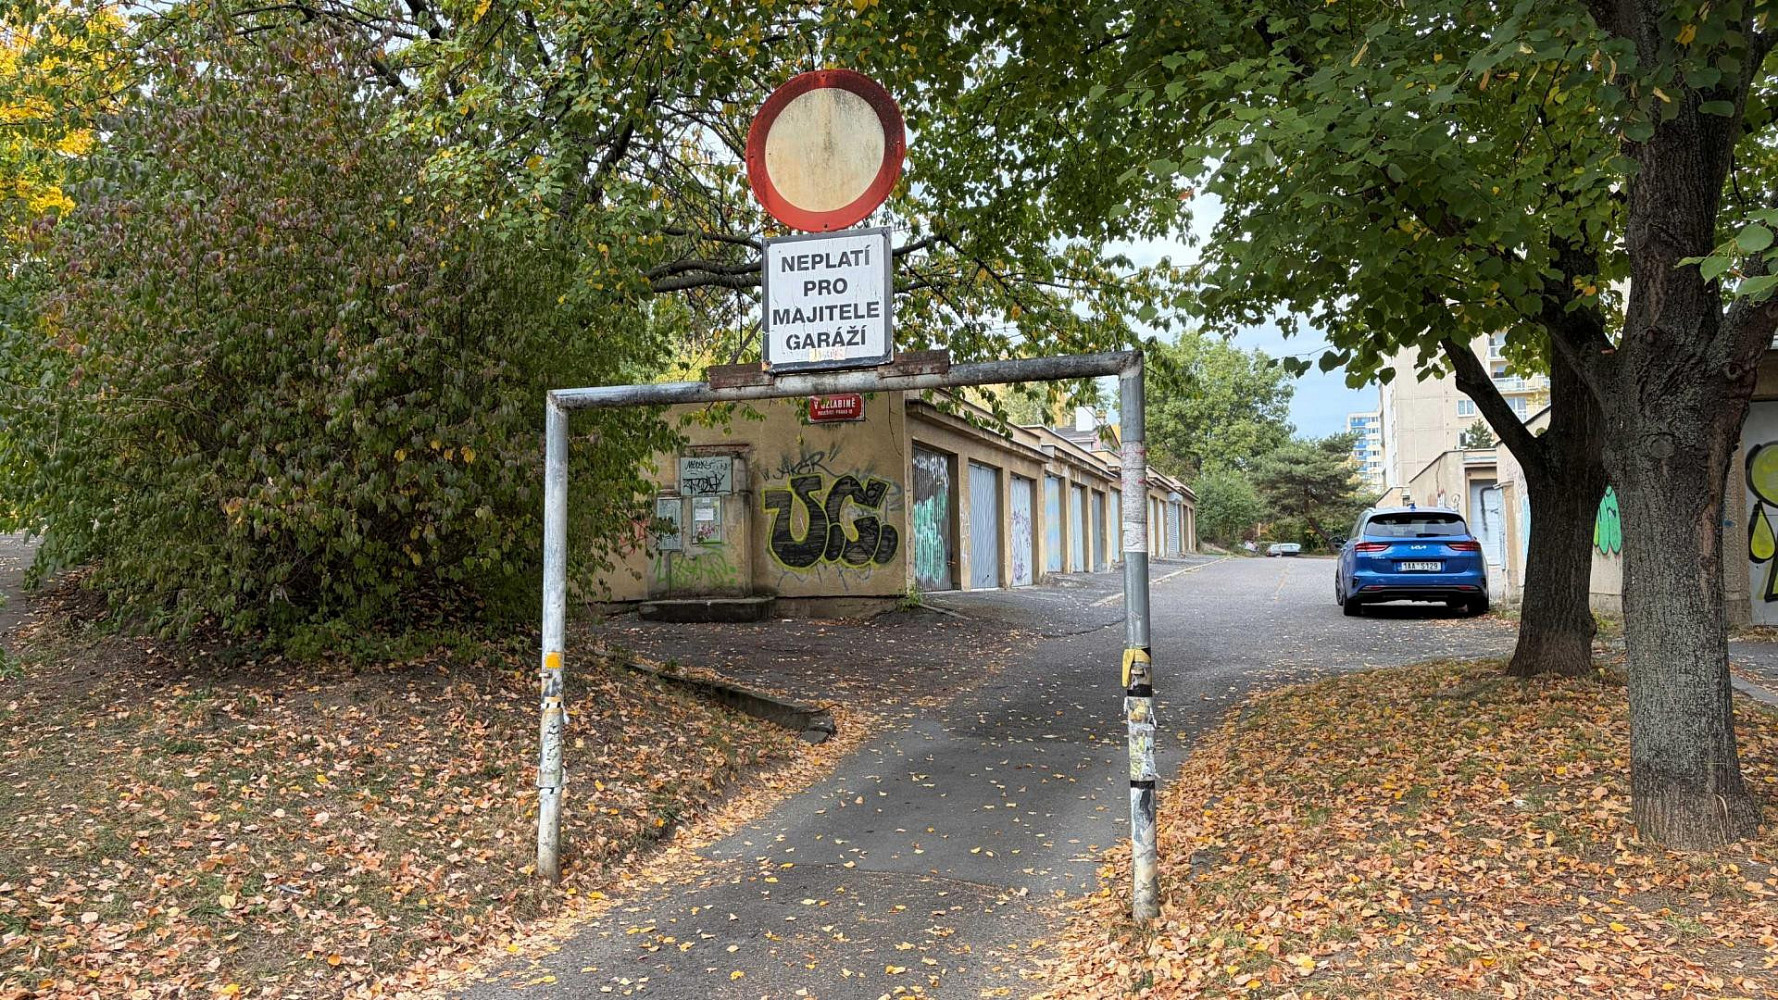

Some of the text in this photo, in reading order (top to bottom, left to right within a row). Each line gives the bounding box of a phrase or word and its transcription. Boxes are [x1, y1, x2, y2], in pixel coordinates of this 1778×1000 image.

[781, 244, 871, 273] NEPLATÍ
[803, 277, 848, 297] PRO
[772, 300, 880, 326] MAJITELE
[785, 324, 868, 351] GARÁŽÍ
[813, 400, 819, 410] V
